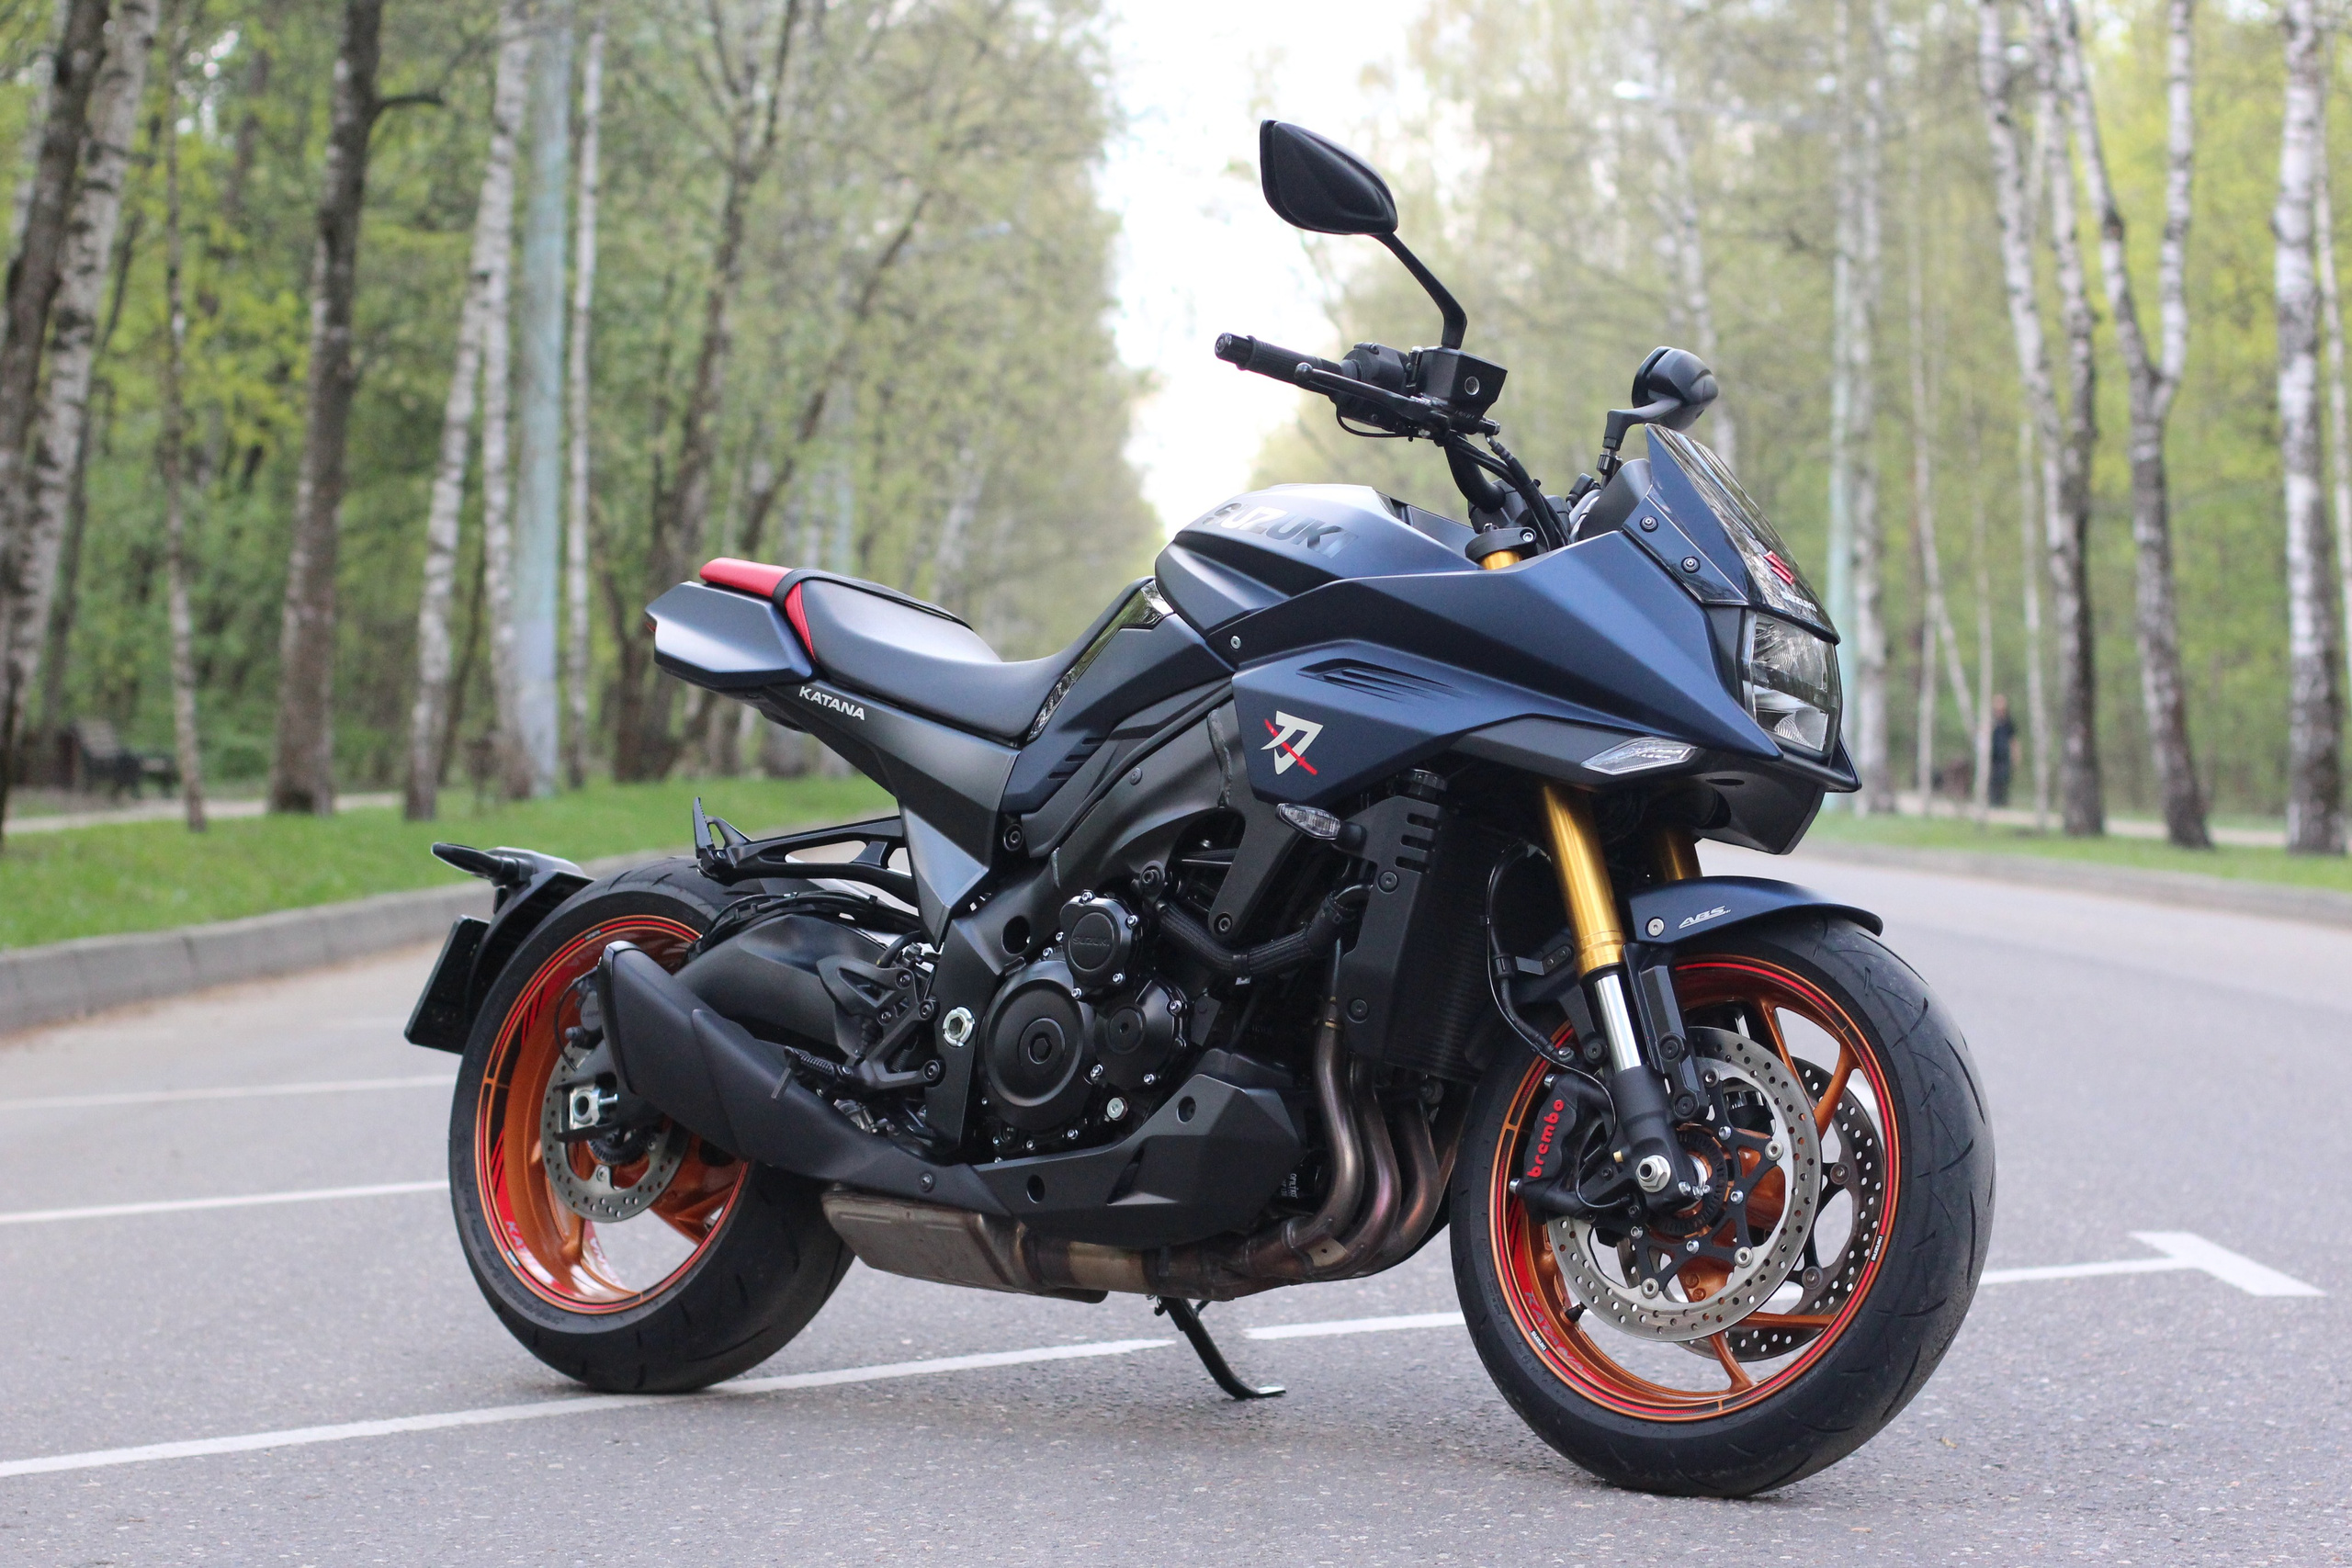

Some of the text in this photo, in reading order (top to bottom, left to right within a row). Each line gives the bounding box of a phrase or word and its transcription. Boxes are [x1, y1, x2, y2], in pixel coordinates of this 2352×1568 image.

[1202, 502, 1359, 558] SUZUKI
[798, 685, 865, 721] KATANA
[1679, 905, 1726, 930] ABS
[1071, 936, 1111, 947] SUZUKI
[1526, 1099, 1565, 1178] brembo
[1525, 1290, 1584, 1371] KATANA
[1531, 1330, 1547, 1351] SUZUKI
